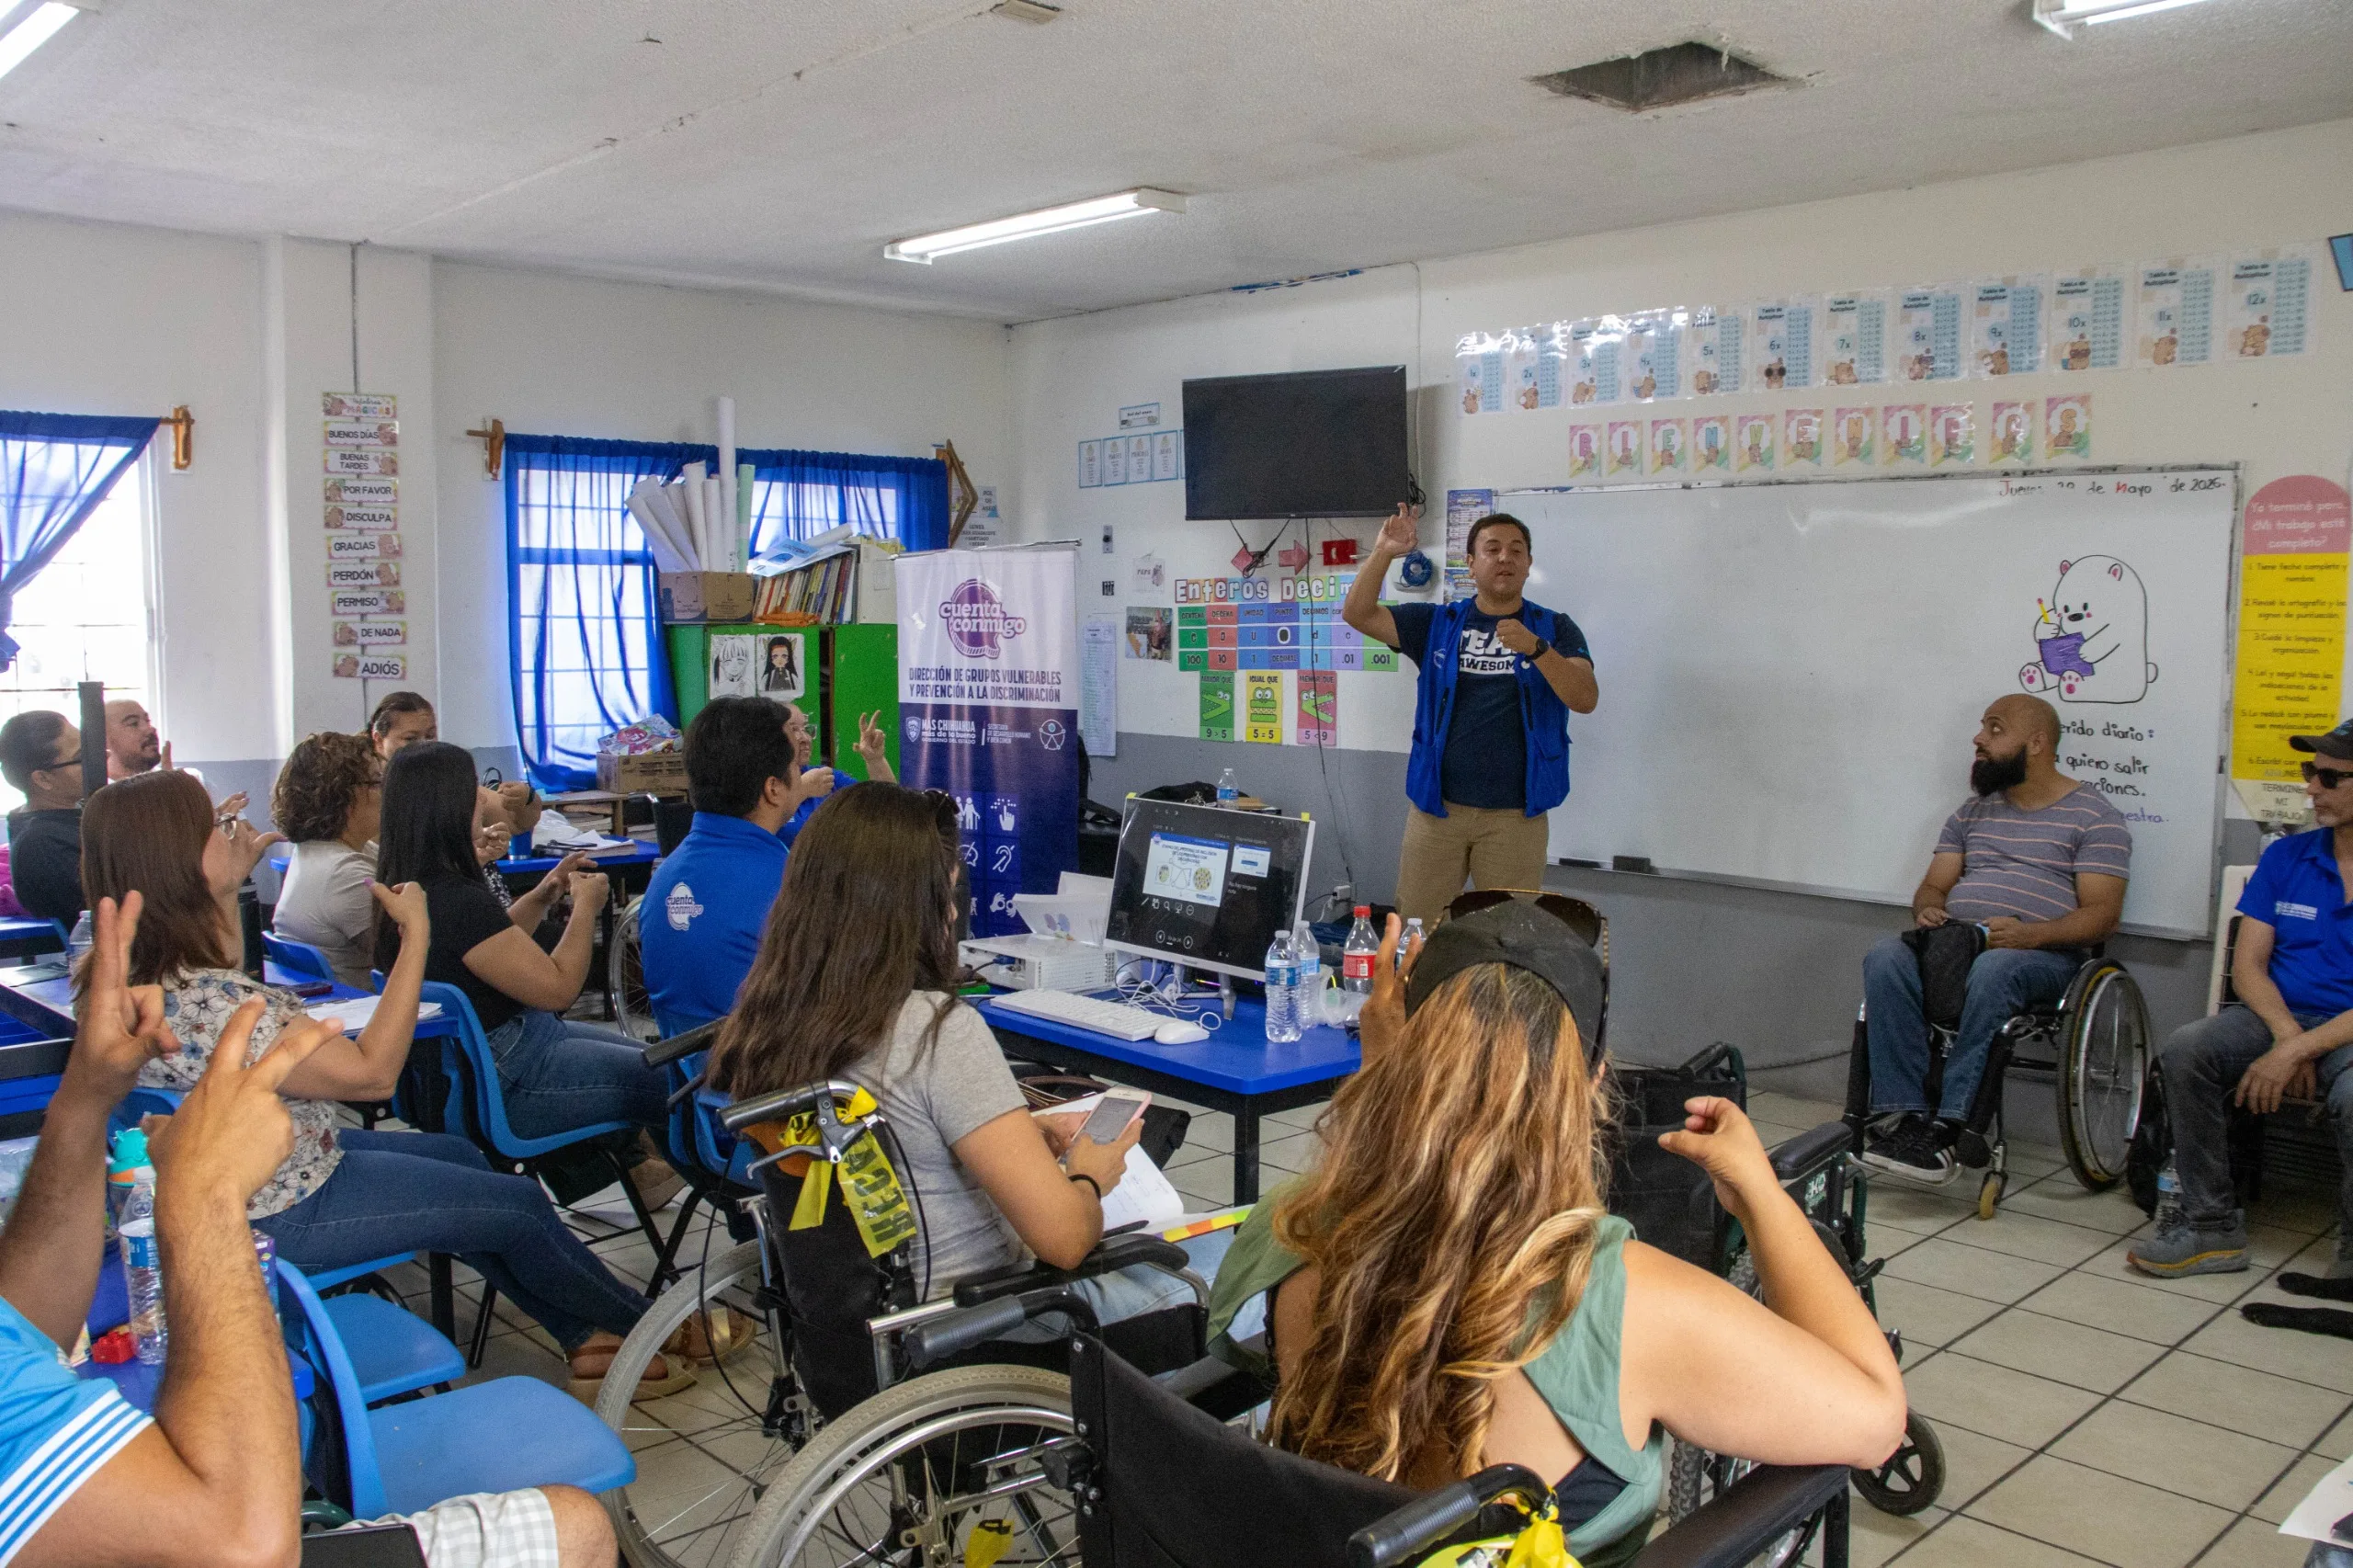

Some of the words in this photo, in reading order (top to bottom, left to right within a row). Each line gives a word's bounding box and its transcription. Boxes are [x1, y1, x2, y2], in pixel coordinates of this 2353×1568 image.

[2246, 293, 2268, 305] 12x
[2068, 317, 2086, 327] 10x
[1915, 331, 1926, 341] 8x
[1991, 327, 2003, 338] 9x
[1769, 339, 1780, 350] 6x
[1839, 339, 1850, 349] 7x
[1703, 346, 1713, 356] 5x
[1641, 357, 1650, 366] 4x
[329, 430, 358, 438] BUENOS
[360, 429, 379, 438] DÍAS
[2086, 481, 2106, 494] de
[2115, 483, 2153, 497] Mayo
[2170, 478, 2186, 493] de
[347, 513, 392, 522] DISCULPA
[334, 541, 376, 551] GRACIAS
[334, 569, 374, 580] PERDÓN
[1176, 579, 1268, 603] Enteros
[337, 597, 379, 607] PERMISO
[940, 600, 1002, 618] cuenta
[361, 629, 372, 637] DE
[375, 628, 401, 637] NADA
[952, 617, 1026, 638] conmigo
[1191, 633, 1197, 642] C
[1221, 631, 1225, 641] D
[1251, 631, 1256, 640] U
[1313, 630, 1318, 639] d
[1460, 629, 1518, 655] TEA
[1187, 655, 1201, 665] 100
[1218, 654, 1226, 664] 10
[1342, 653, 1354, 664] .01
[1370, 654, 1391, 665] .001
[361, 661, 400, 675] ADIÓS
[1460, 658, 1515, 672] AWESOM
[909, 665, 951, 682] DIRECCIÓN
[954, 668, 963, 682] DE
[965, 668, 1001, 683] GRUPOS
[1003, 670, 1062, 686] VULNERABLES
[1222, 676, 1233, 684] QUE
[1267, 676, 1278, 685] QUE
[1323, 676, 1334, 684] QUE
[909, 685, 915, 698] Y
[916, 683, 966, 699] PREVENCIÓN
[968, 686, 974, 699] A
[976, 686, 988, 699] LA
[990, 687, 1061, 702] DISCRIMINACIÓN
[922, 719, 937, 731] MÁS
[938, 720, 975, 732] CHIHUAHUA
[2059, 720, 2095, 736] erido
[1206, 728, 1211, 738] 9
[1222, 729, 1227, 738] 5
[1253, 729, 1258, 739] 5
[1268, 730, 1274, 739] 5
[1304, 731, 1311, 740] 5
[1322, 731, 1327, 741] 9
[2066, 754, 2109, 771] quiero
[2114, 756, 2149, 775] salir
[2121, 807, 2168, 823] estra.
[667, 894, 693, 904] cuenta
[669, 905, 704, 917] conmigo
